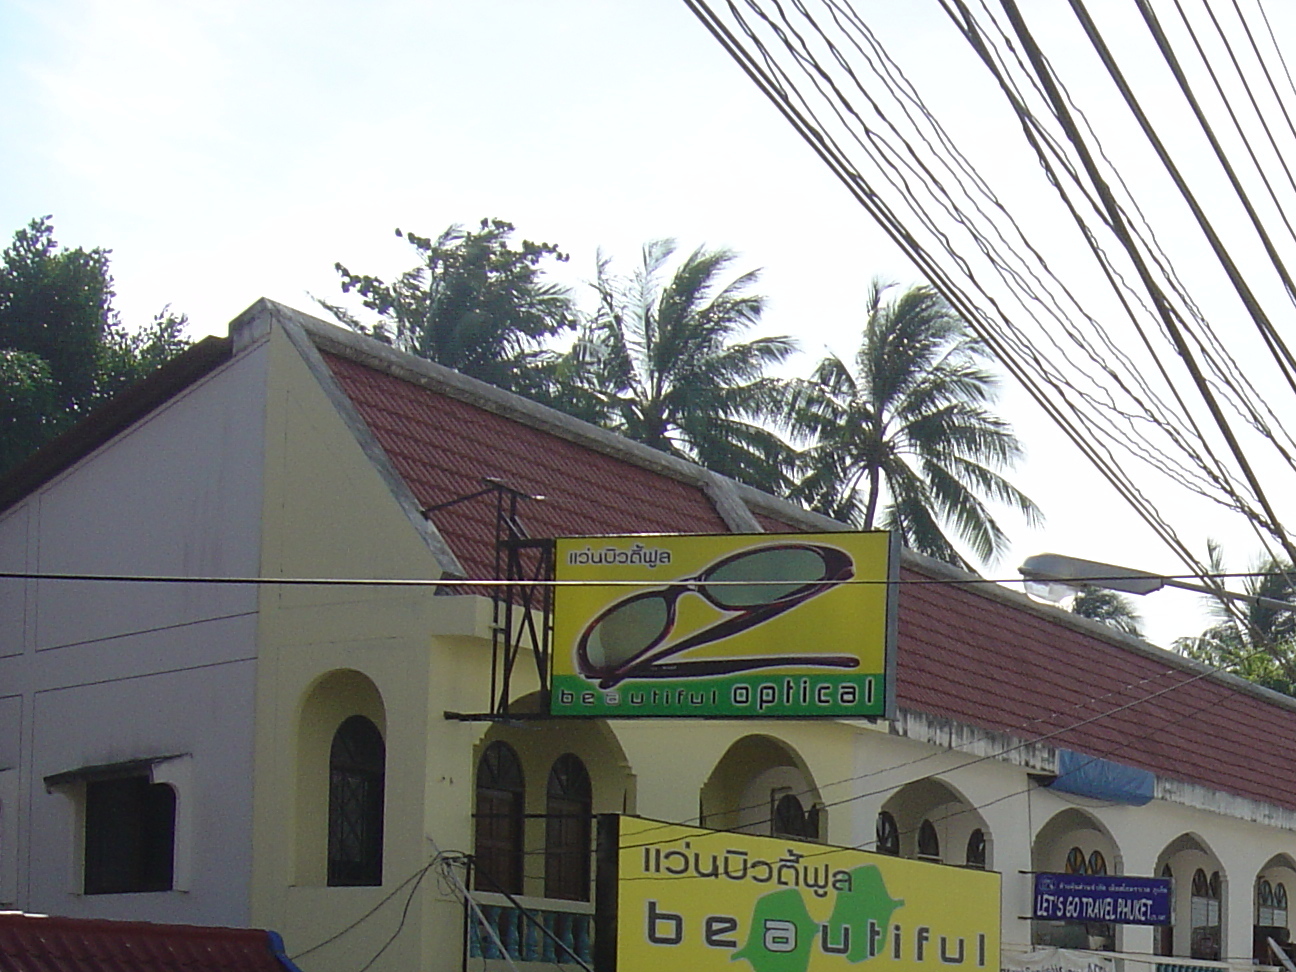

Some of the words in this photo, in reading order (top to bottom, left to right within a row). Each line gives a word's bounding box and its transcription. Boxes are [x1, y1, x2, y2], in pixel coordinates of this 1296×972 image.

[559, 687, 718, 708] beautiful
[732, 677, 874, 710] optical
[1036, 893, 1064, 917] LET'S
[1065, 896, 1080, 918] GO
[1082, 896, 1116, 921] TRAVEL
[1117, 897, 1153, 922] PHUKET
[646, 900, 986, 967] beautiful
